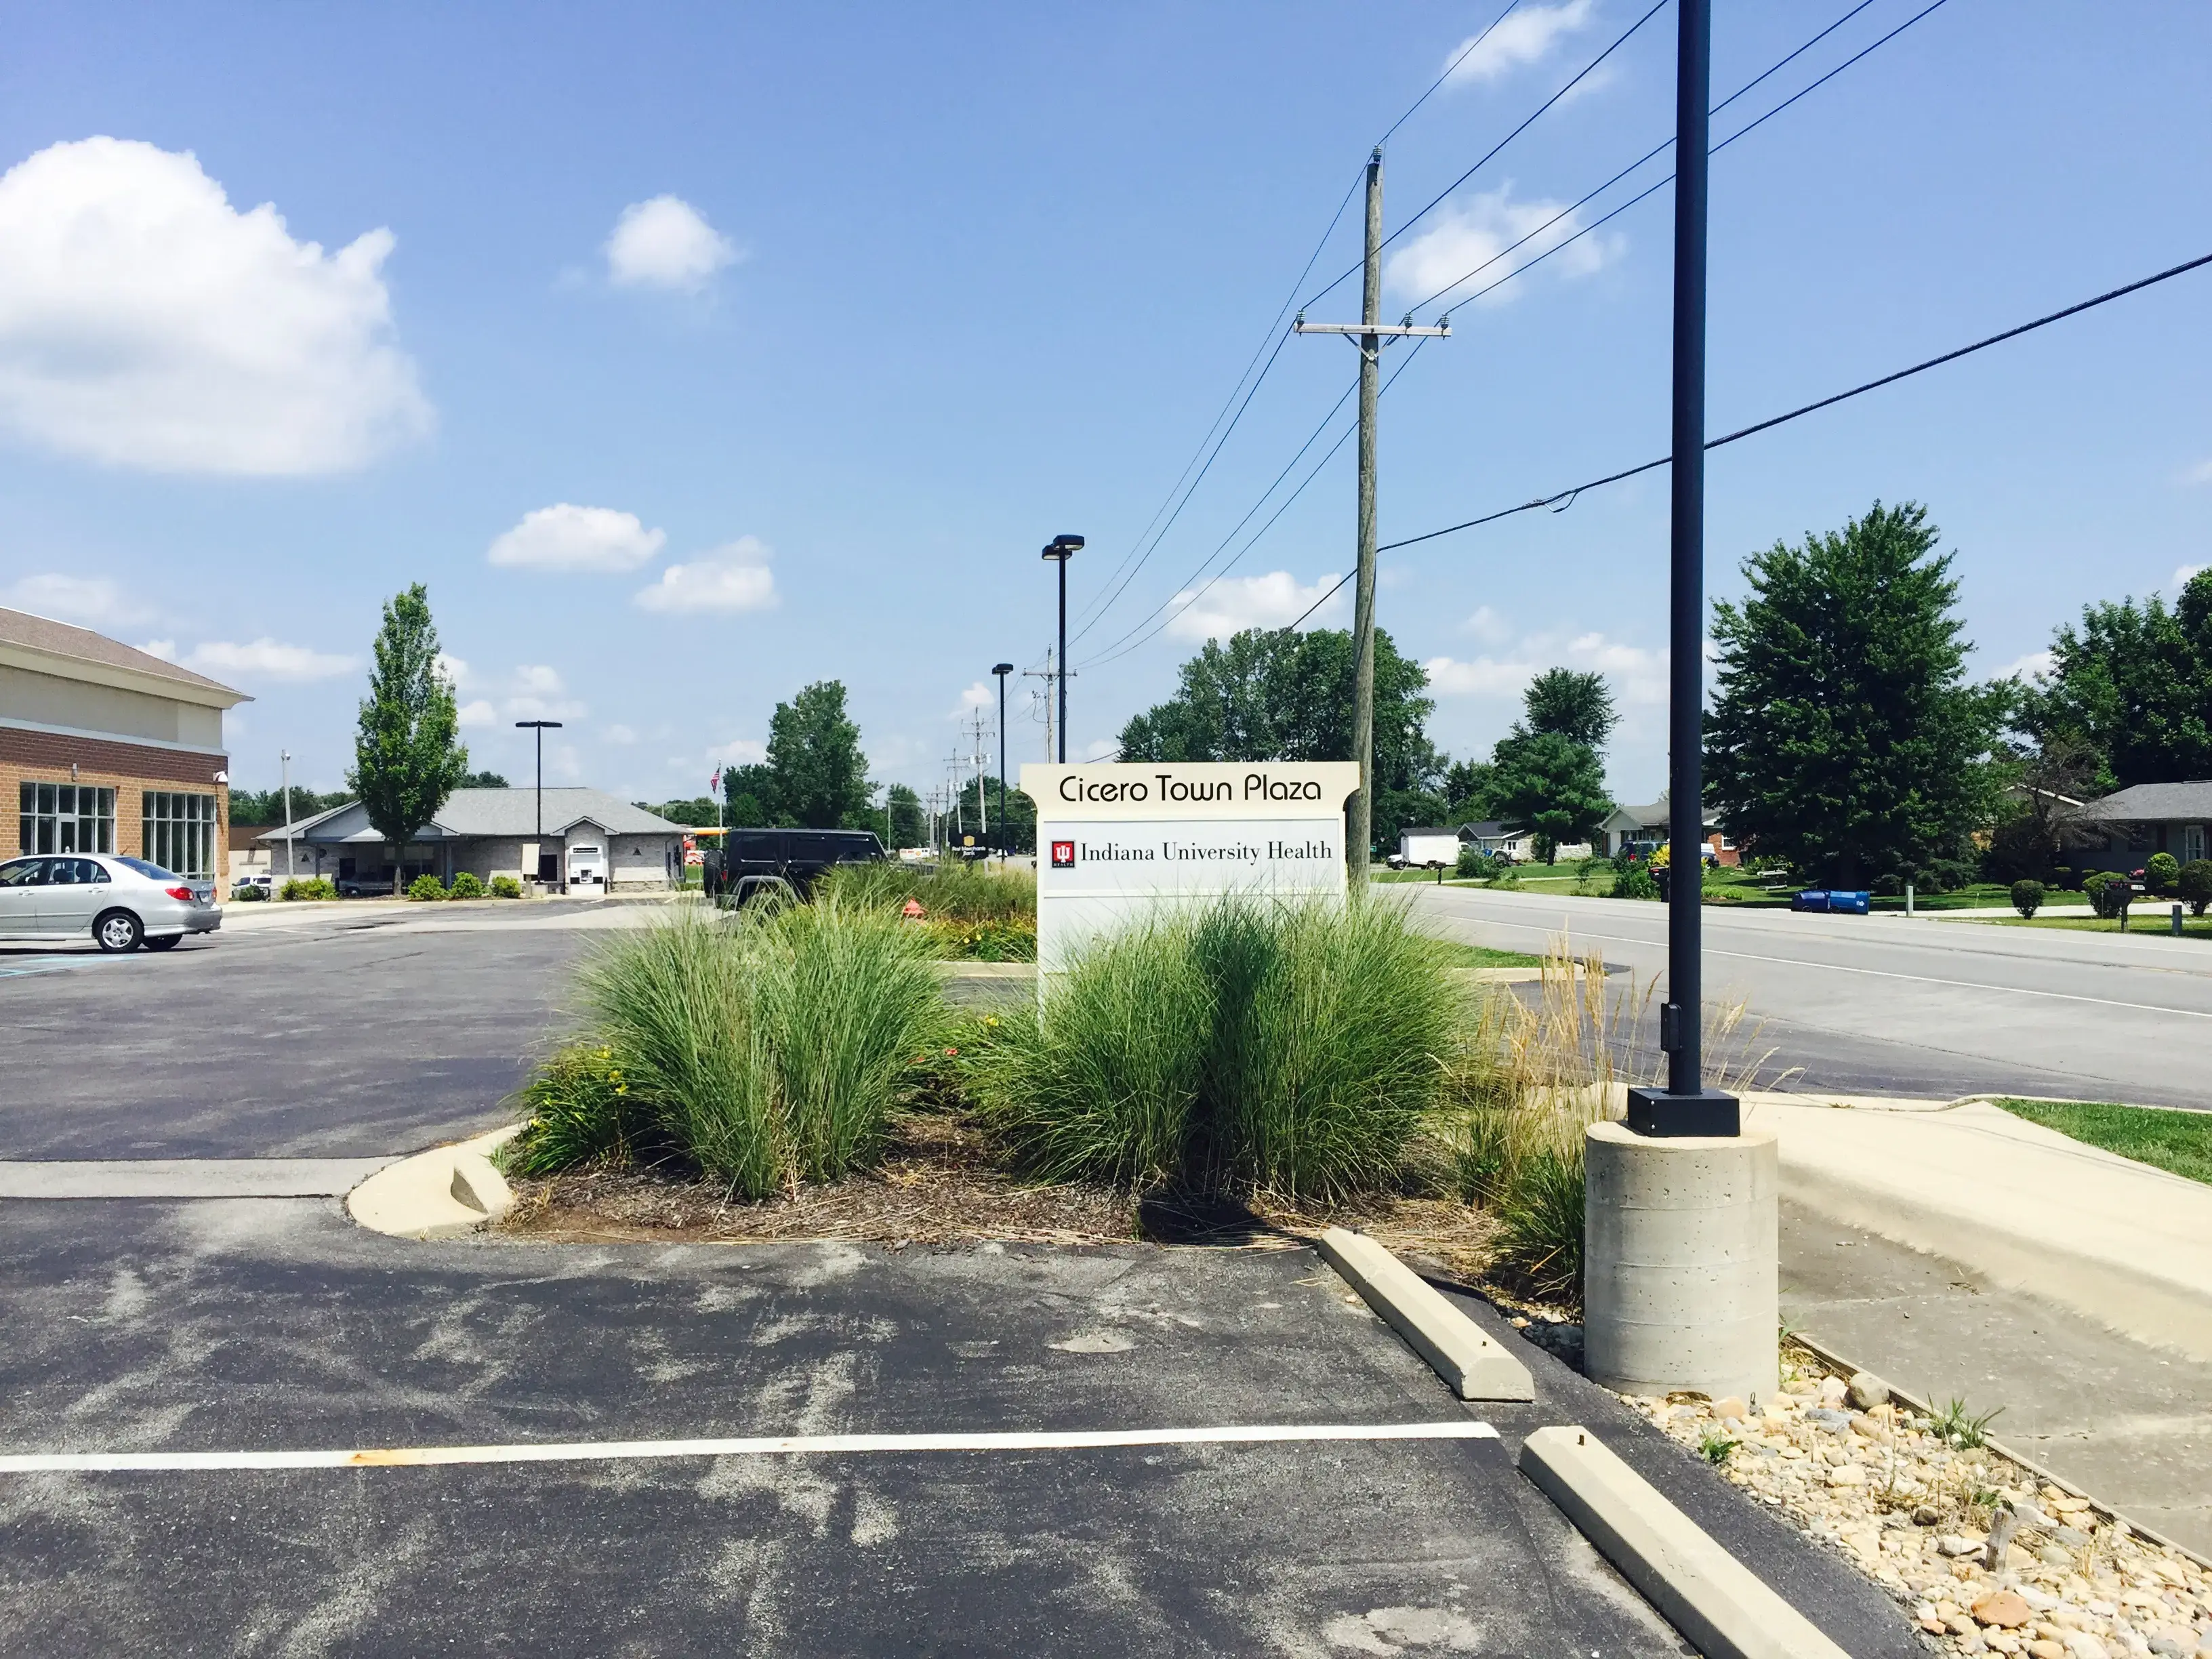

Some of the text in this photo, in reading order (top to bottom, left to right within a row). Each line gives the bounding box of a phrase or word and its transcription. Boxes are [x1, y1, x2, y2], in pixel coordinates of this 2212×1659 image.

[1059, 773, 1322, 802] Cicero Town Plaza
[1081, 840, 1332, 866] Indiana University Health
